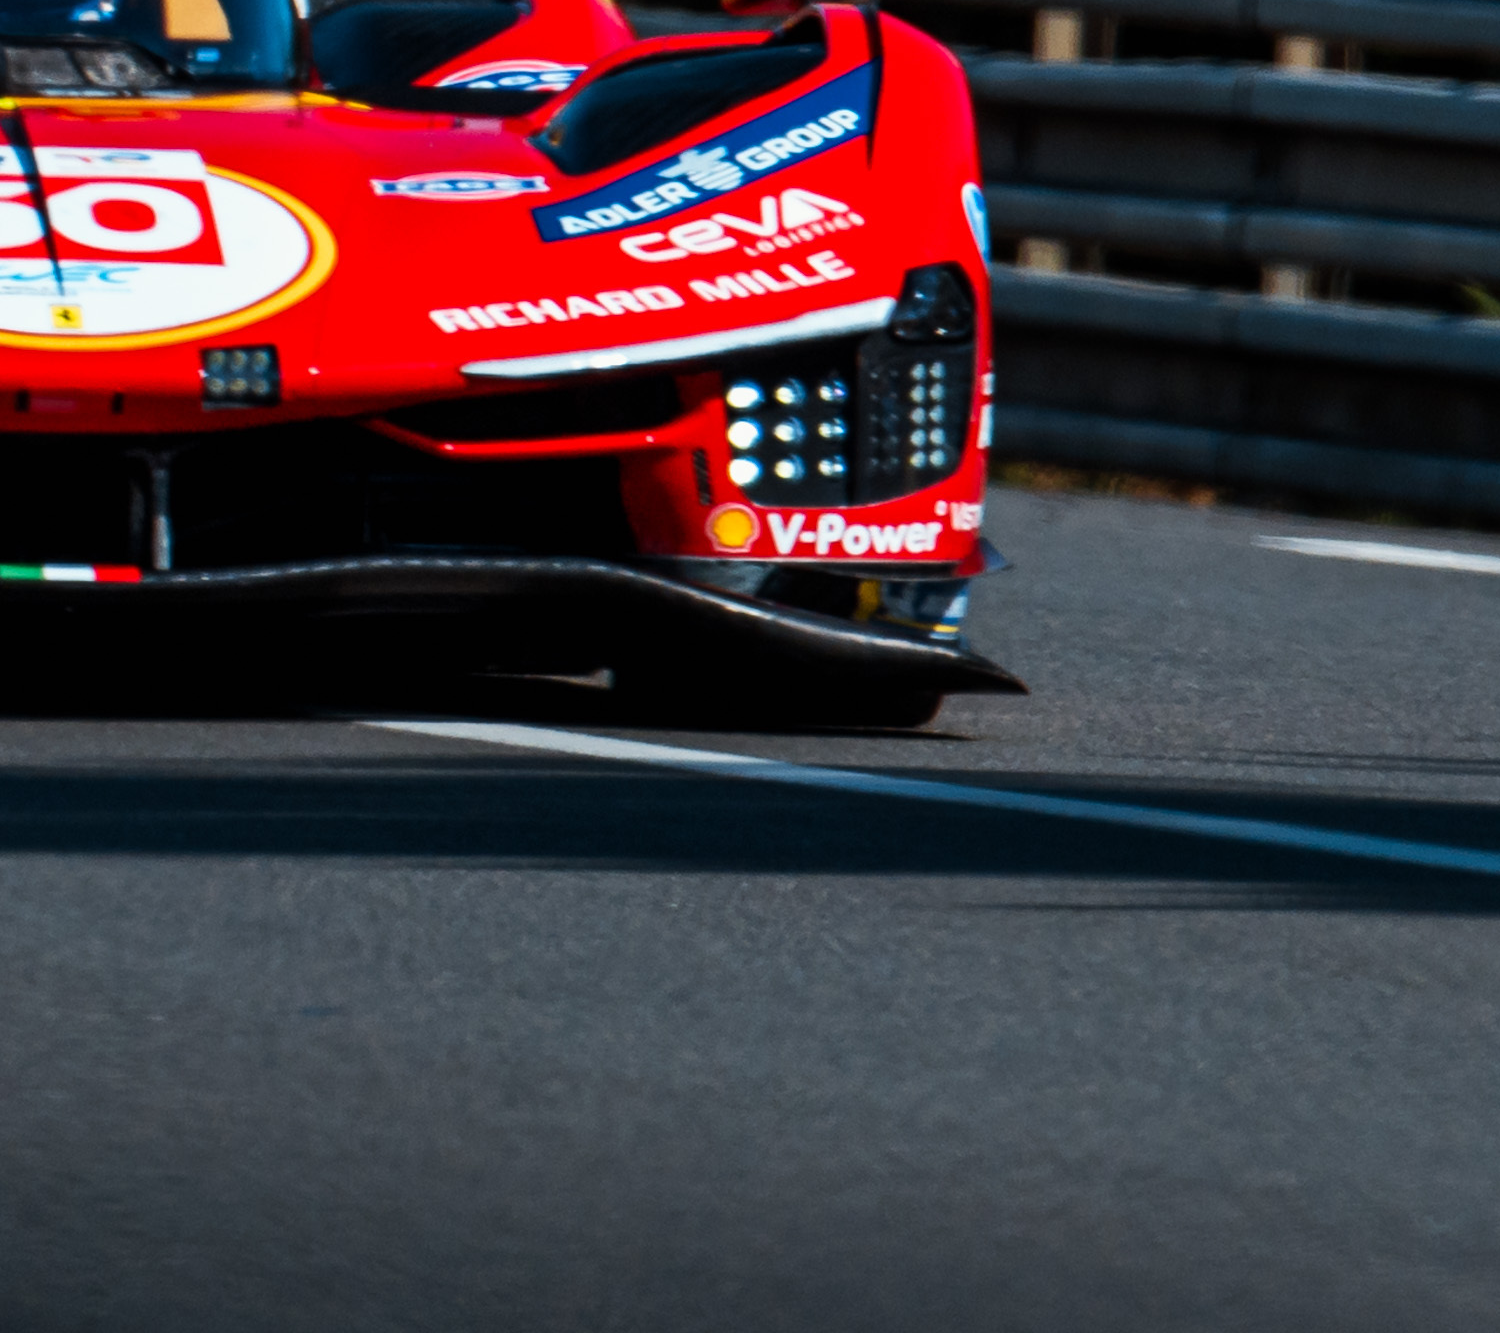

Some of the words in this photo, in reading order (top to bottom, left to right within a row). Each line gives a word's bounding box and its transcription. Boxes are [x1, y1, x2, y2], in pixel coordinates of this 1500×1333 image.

[558, 181, 700, 236] ADLER
[734, 108, 860, 172] GROUP
[428, 284, 685, 334] RICHARD
[688, 250, 856, 303] MILLE
[769, 510, 943, 556] V-Power
